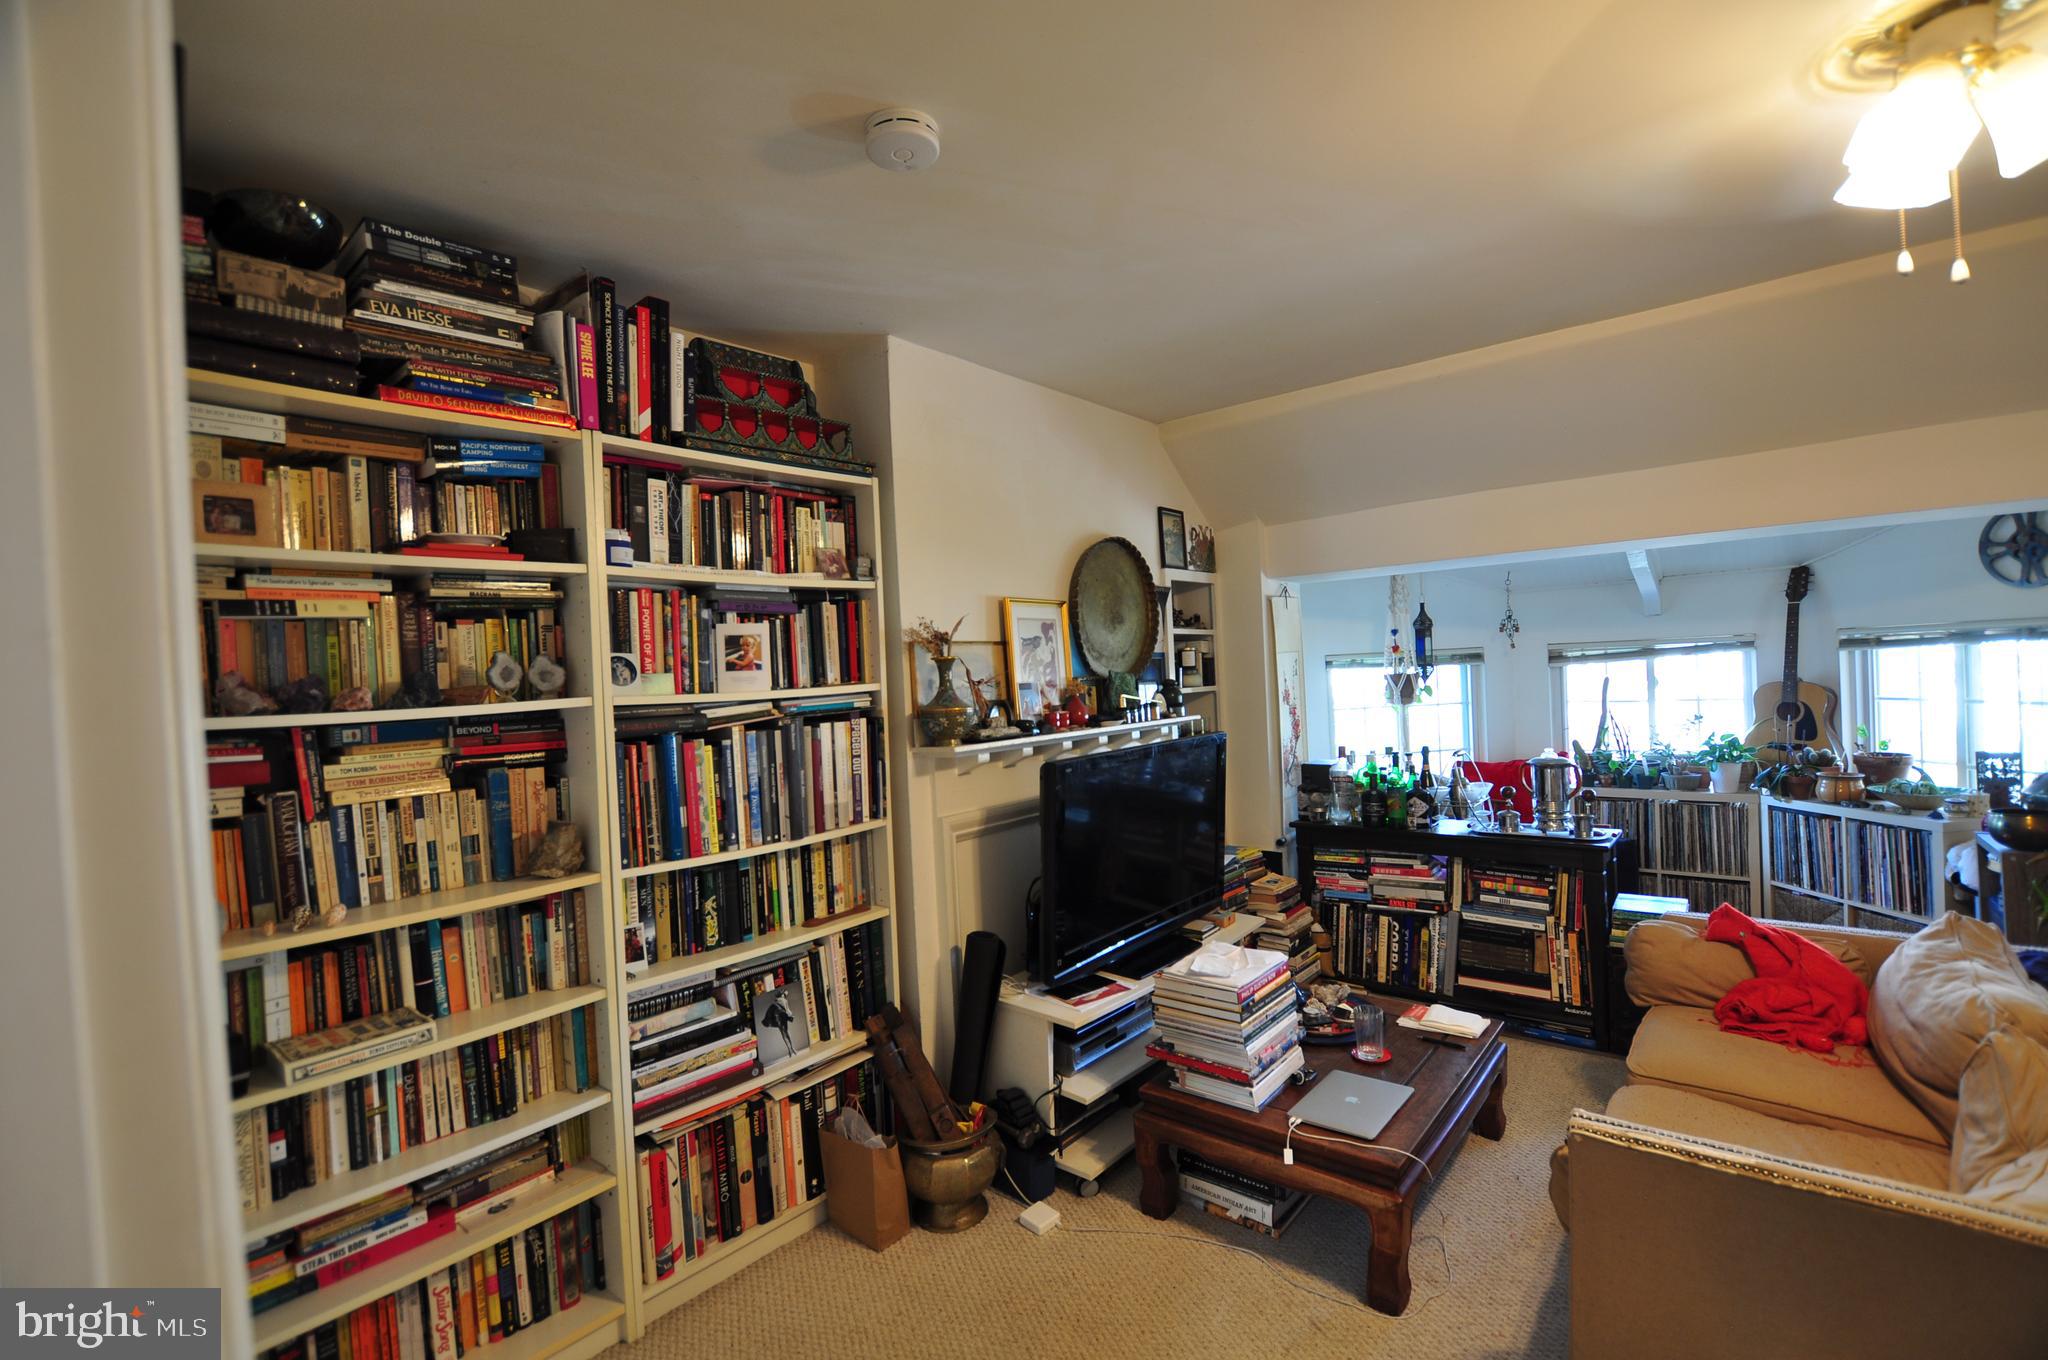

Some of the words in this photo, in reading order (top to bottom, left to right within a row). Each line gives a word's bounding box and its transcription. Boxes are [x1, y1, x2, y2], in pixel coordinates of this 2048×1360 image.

[380, 223, 402, 237] The
[404, 230, 442, 248] Double
[368, 300, 401, 318] EVA
[406, 306, 454, 328] HESSE
[604, 292, 612, 318] SCIENCE
[404, 342, 440, 357] Whole
[441, 348, 472, 361] Earth
[580, 331, 592, 360] SPIKE
[605, 324, 613, 366] TECHNOLOGY
[412, 363, 434, 374] GONE
[434, 367, 456, 376] WITH
[457, 370, 470, 379] THE
[471, 372, 492, 383] WIND
[582, 361, 594, 380] LEE
[398, 390, 430, 403] DAVID
[446, 397, 498, 415] SELZNICK'S
[460, 442, 488, 450] PACIFIC
[489, 444, 530, 452] NORTHWEST
[462, 449, 494, 457] CAMPING
[490, 462, 529, 470] NORTHWEST
[642, 608, 651, 641] POWER
[643, 642, 652, 656] OF
[644, 657, 652, 674] ART
[456, 726, 492, 734] BEYOND
[852, 754, 862, 776] OUT
[368, 776, 406, 785] ROBBINS
[1389, 898, 1406, 908] ANNA
[853, 928, 864, 992] TITIAN
[629, 996, 668, 1020] FACTORY
[670, 988, 694, 1010] MADE
[404, 1074, 414, 1103] DUNE
[678, 1136, 687, 1180] BAUHAUS
[718, 1172, 730, 1202] MIRÓ
[1191, 1184, 1222, 1200] AMERICAN
[1222, 1196, 1243, 1208] INDIAN
[1244, 1206, 1256, 1217] ART
[302, 1256, 326, 1273] STEAL
[328, 1248, 346, 1262] THIS
[348, 1238, 368, 1254] BOOK
[432, 1286, 450, 1322] Sailor
[435, 1322, 453, 1354] Song
